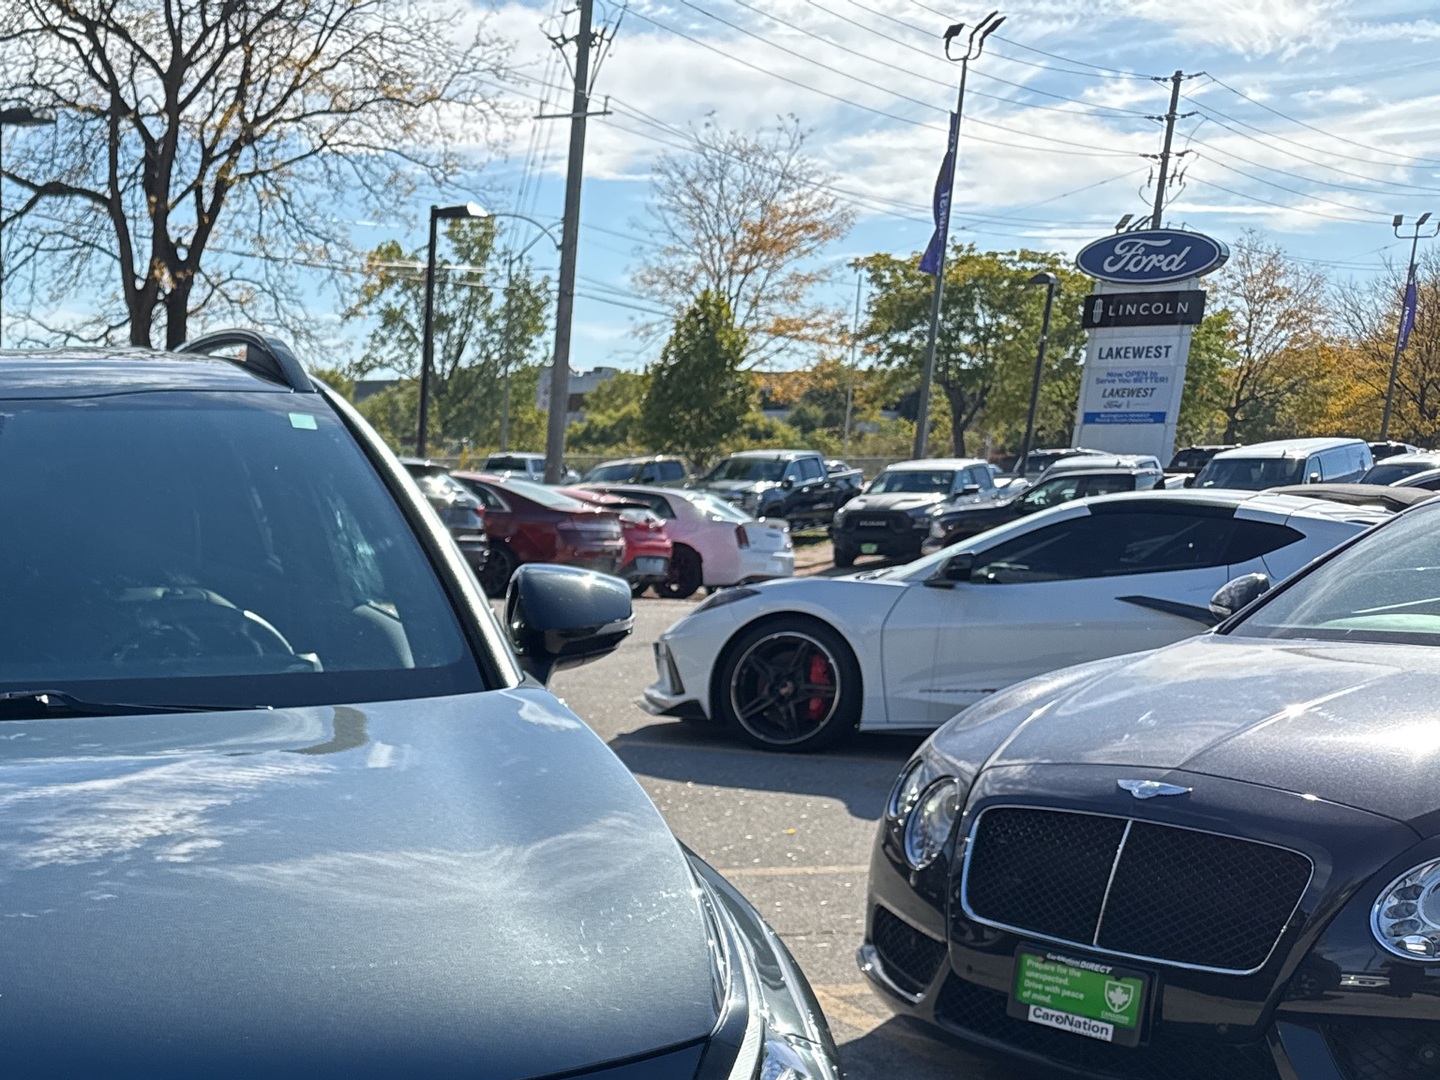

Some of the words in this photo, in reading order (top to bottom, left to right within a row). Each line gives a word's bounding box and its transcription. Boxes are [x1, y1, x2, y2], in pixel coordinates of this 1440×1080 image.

[1103, 239, 1192, 273] Ford
[1109, 302, 1190, 317] LINCOLN
[1098, 345, 1172, 360] LAKEWEST
[1125, 370, 1148, 378] OPEN
[1101, 387, 1157, 398] LAKEWEST
[1080, 961, 1113, 975] DIRECT
[1022, 990, 1032, 998] of
[1023, 979, 1044, 990] Drive
[1044, 985, 1061, 994] with
[1061, 989, 1085, 1001] peace
